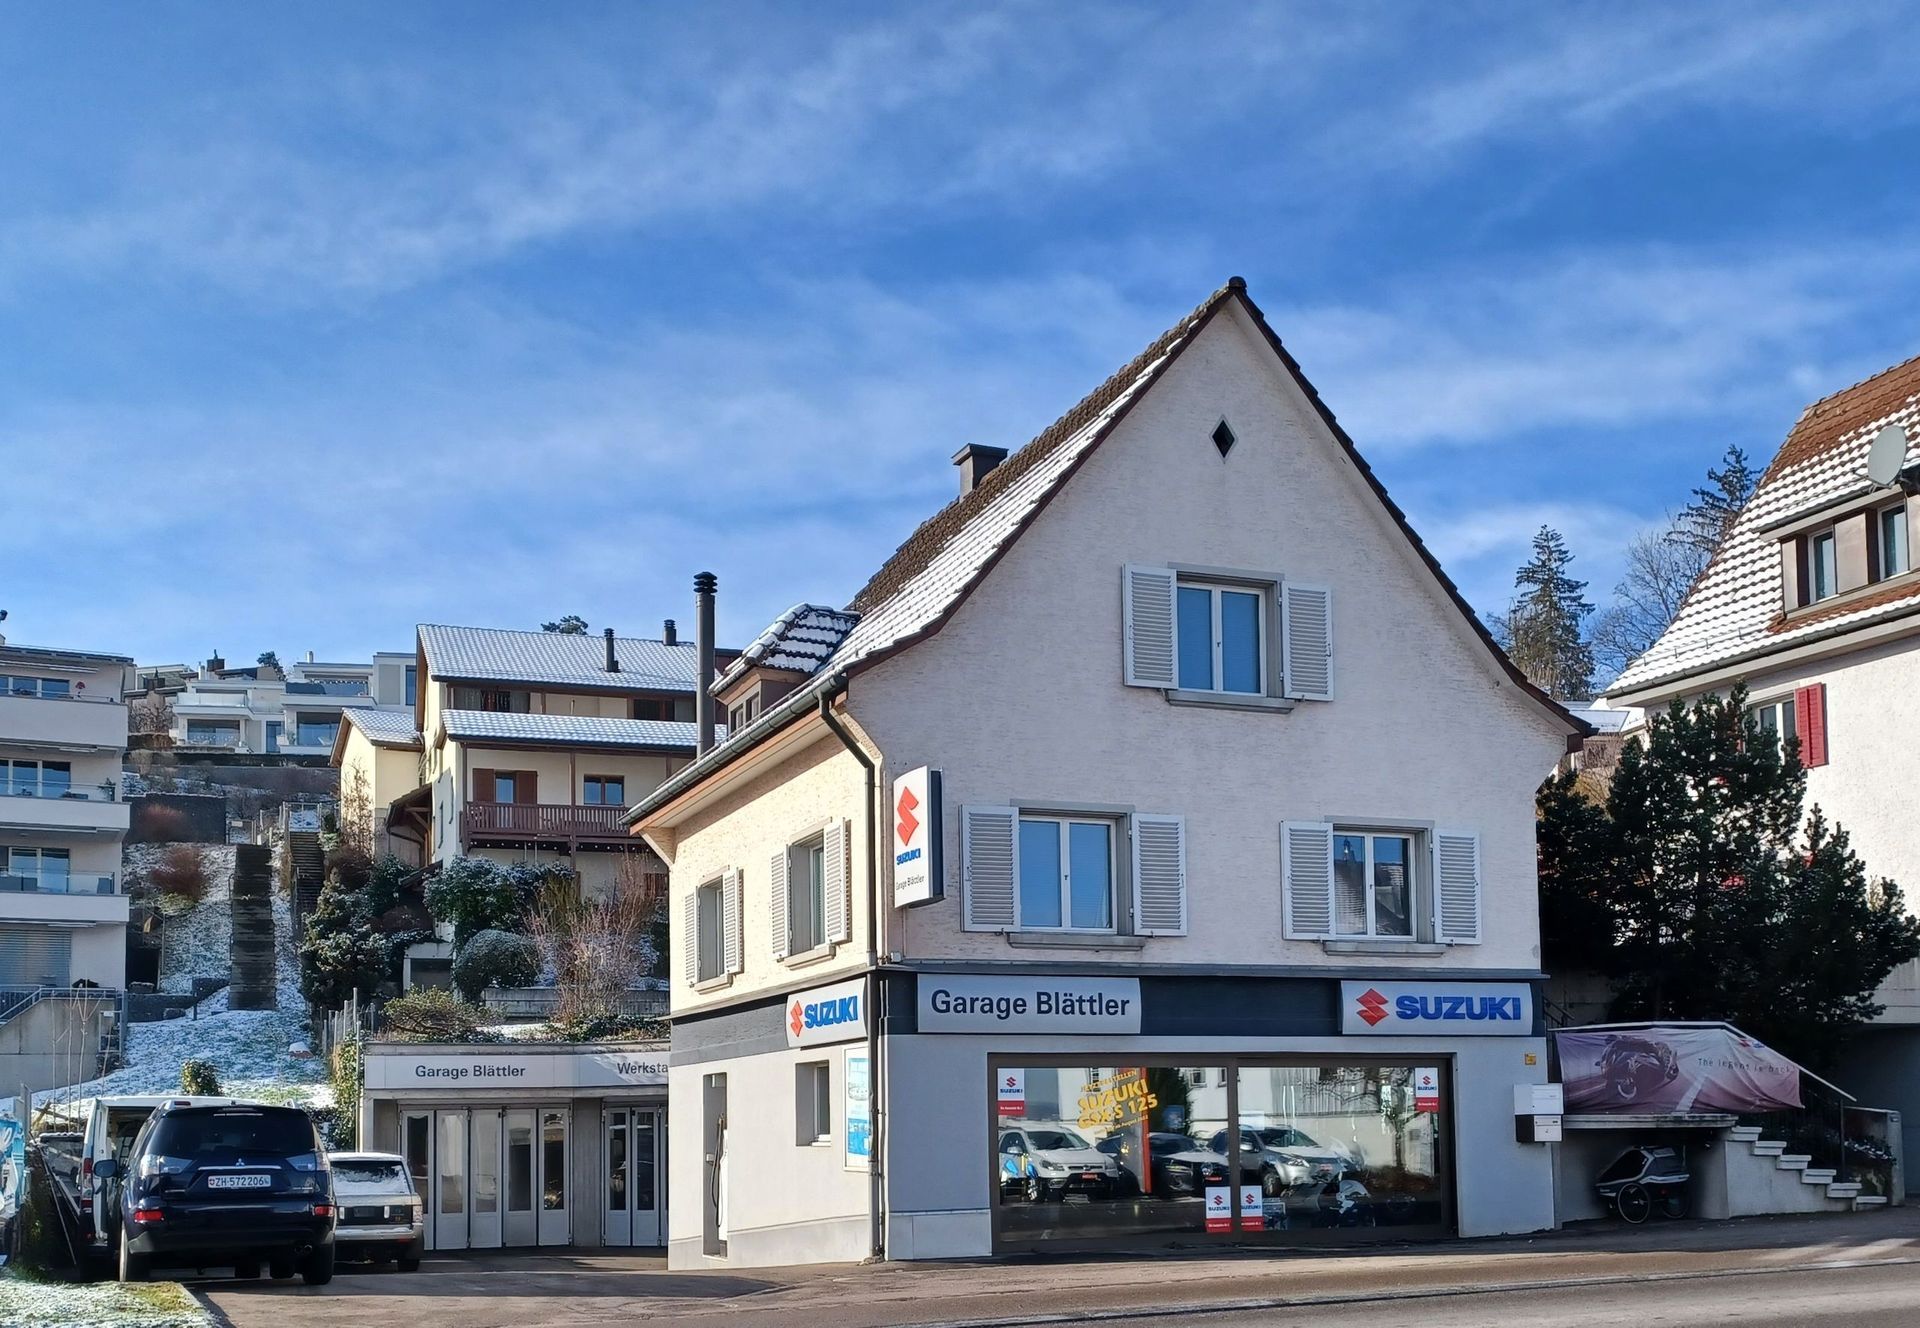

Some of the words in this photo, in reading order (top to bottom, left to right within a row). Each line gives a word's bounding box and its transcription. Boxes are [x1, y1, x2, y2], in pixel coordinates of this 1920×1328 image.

[897, 848, 921, 866] SUZUKI
[804, 995, 858, 1029] SUZUKI
[931, 989, 1027, 1020] Garage
[1036, 991, 1130, 1016] Blättler
[1395, 995, 1521, 1021] SUZUKI
[415, 1065, 468, 1080] Garage
[473, 1065, 526, 1078] Blättler
[617, 1062, 669, 1075] Werksta
[1697, 1058, 1714, 1067] The
[1078, 1079, 1149, 1111] SUZUKI
[1128, 1093, 1158, 1114] 125
